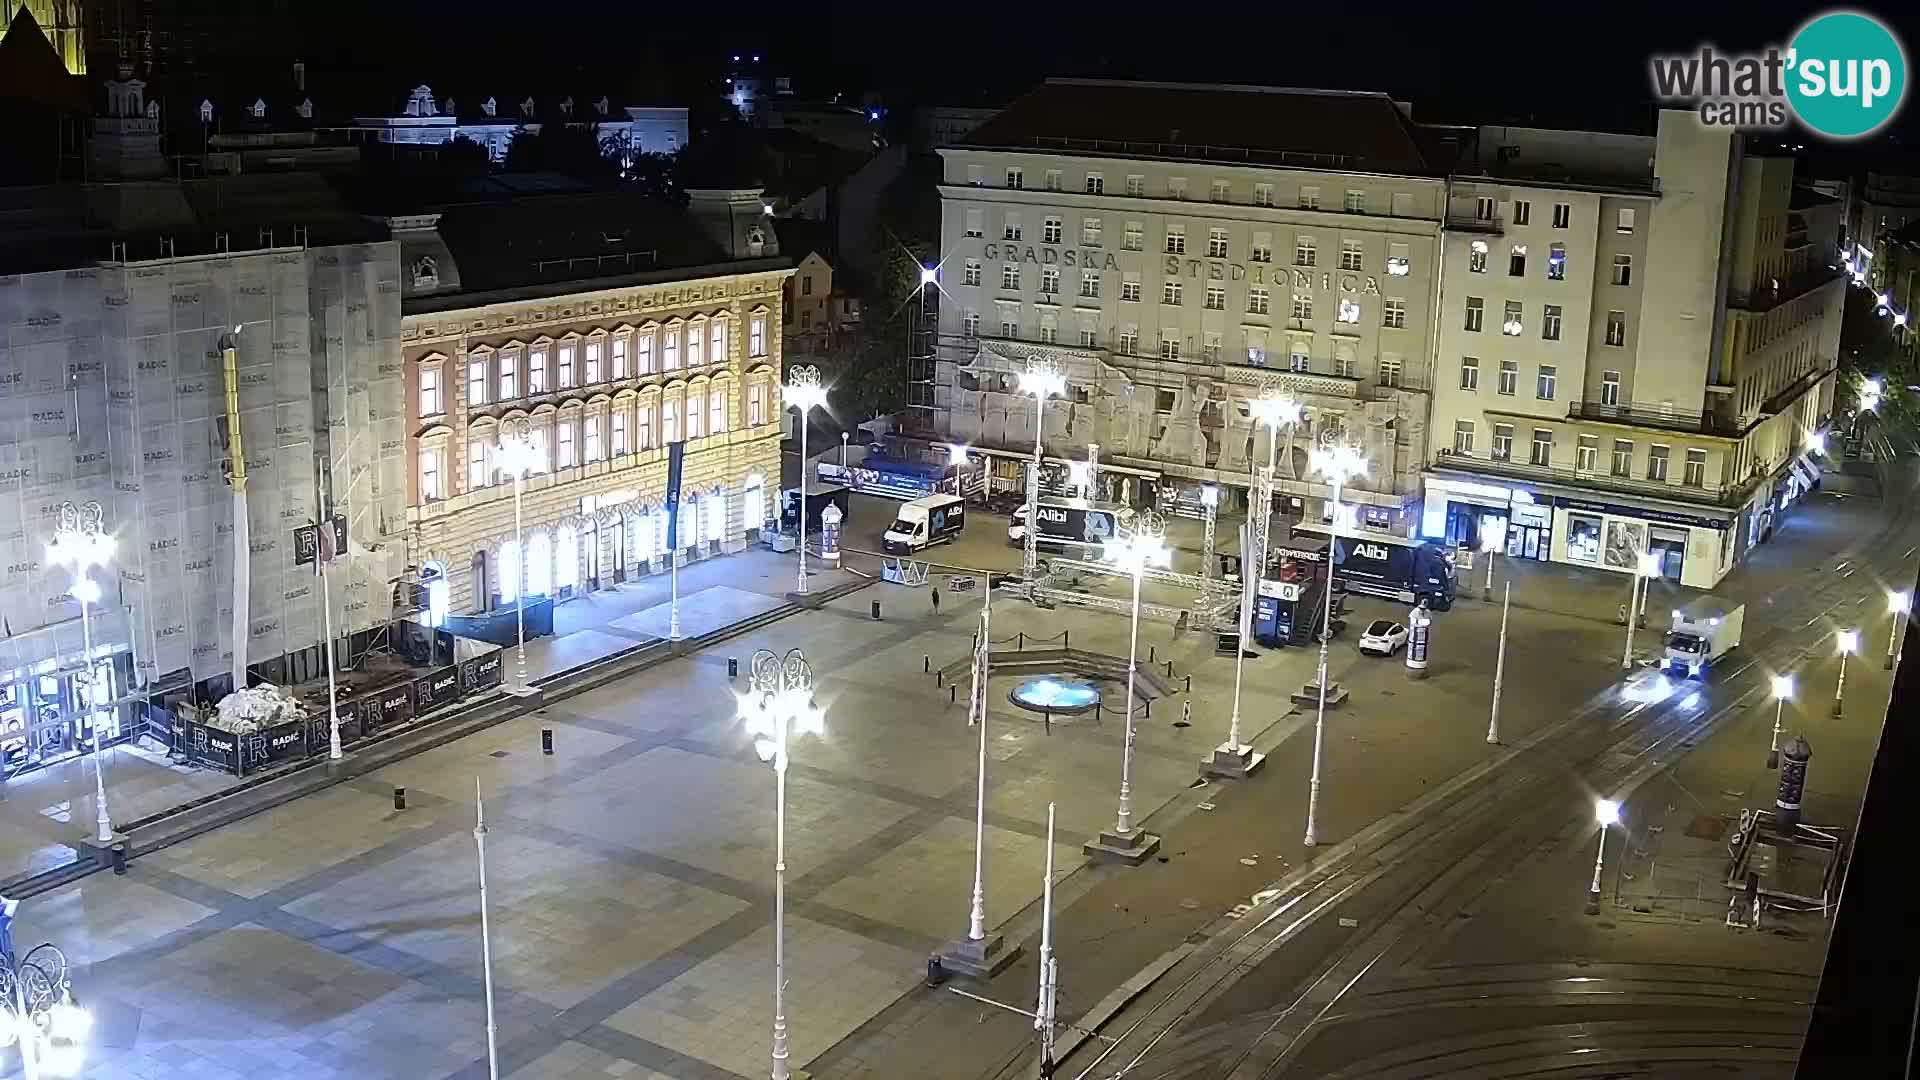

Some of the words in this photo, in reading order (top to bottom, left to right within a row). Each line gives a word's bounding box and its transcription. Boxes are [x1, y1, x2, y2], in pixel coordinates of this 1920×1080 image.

[985, 243, 1120, 272] GRADSKA
[1037, 509, 1067, 523] Alibi
[1353, 543, 1389, 561] Alibi
